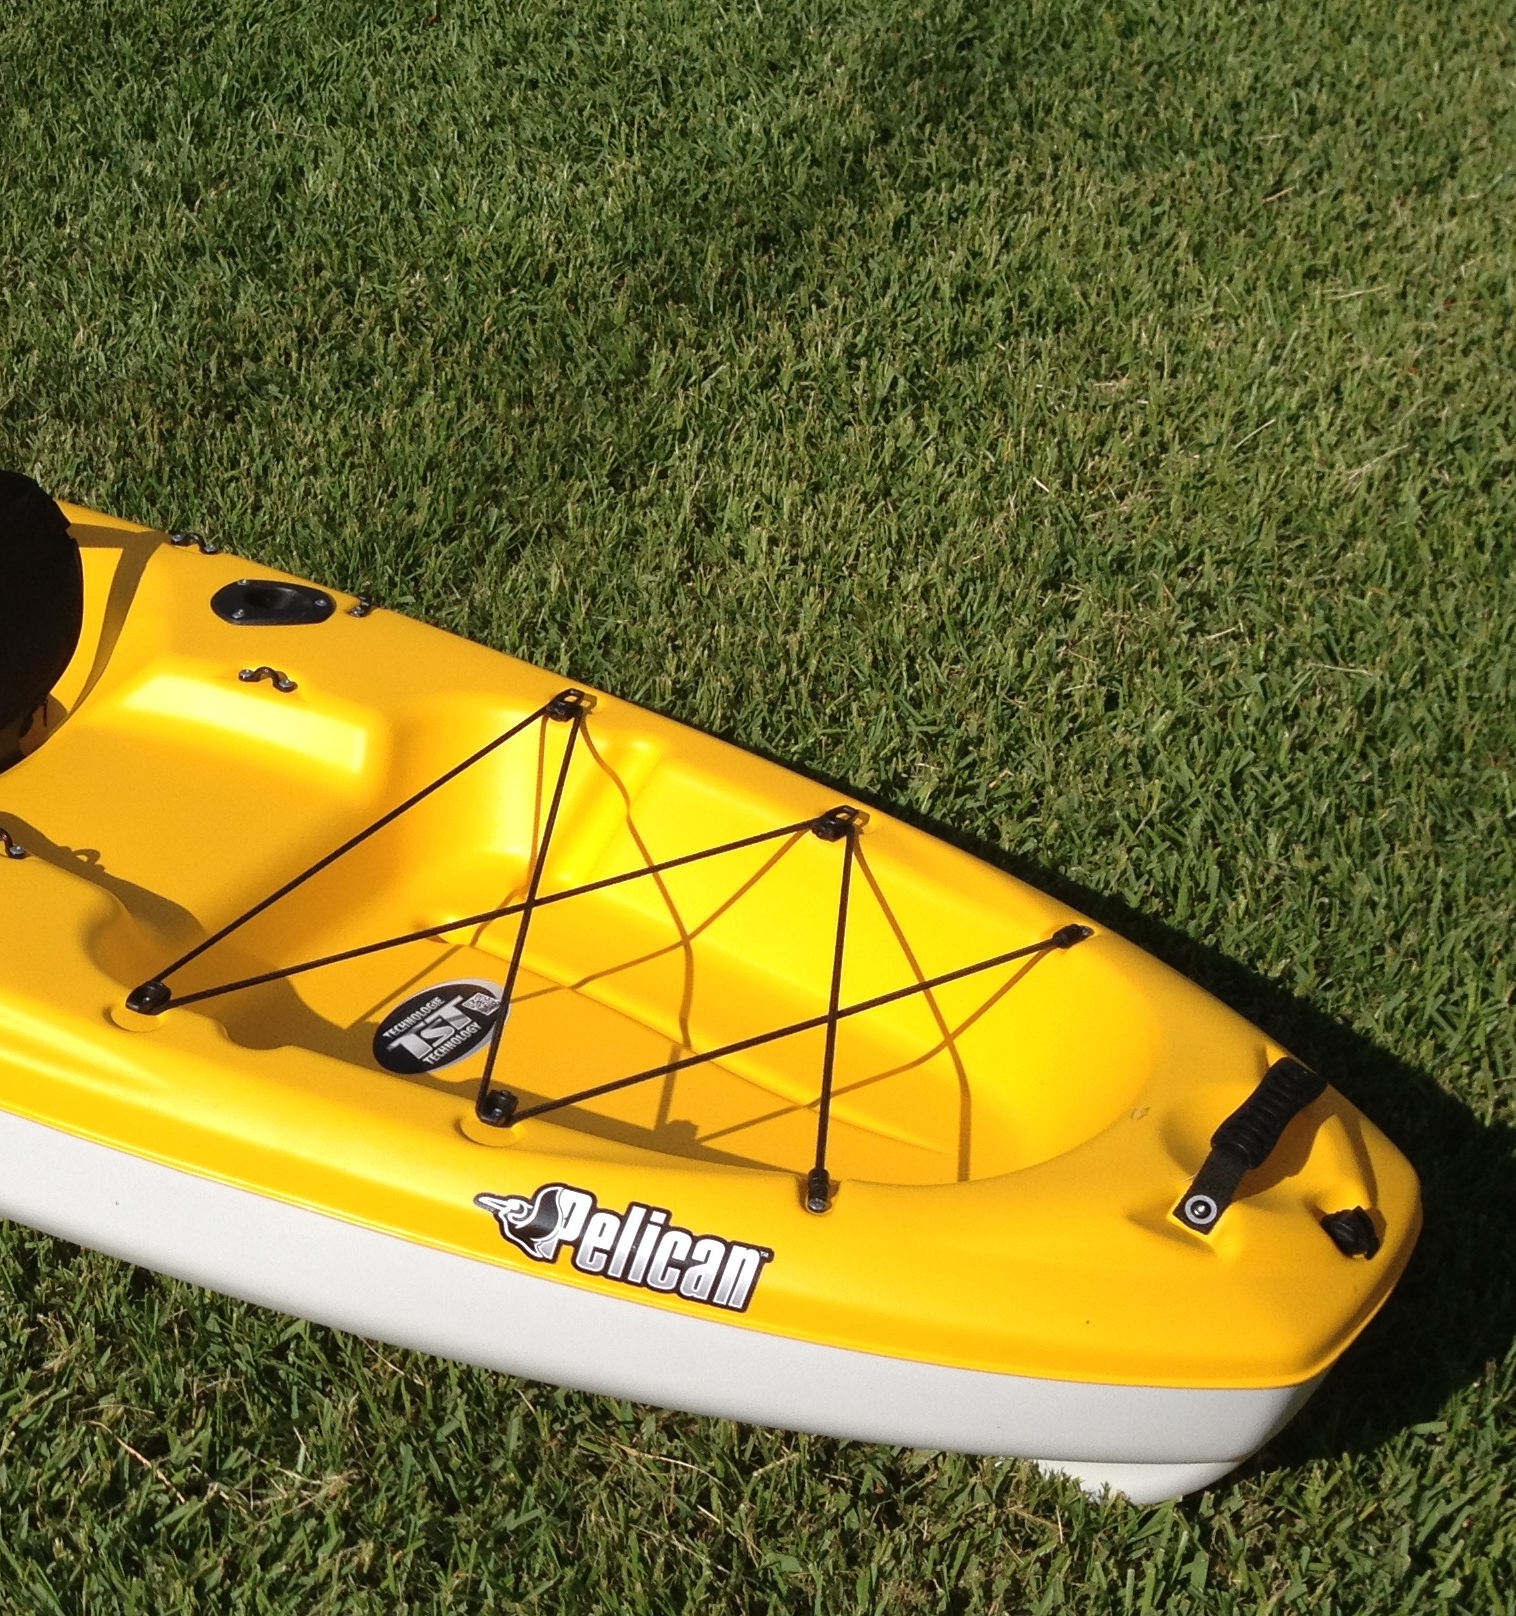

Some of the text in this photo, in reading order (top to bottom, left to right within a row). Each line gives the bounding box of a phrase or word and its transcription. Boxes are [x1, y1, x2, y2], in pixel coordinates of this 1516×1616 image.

[382, 996, 446, 1039] TECHNOLOGIE
[386, 994, 472, 1060] TST
[422, 1021, 482, 1066] TECHNOLOGY
[539, 1186, 762, 1310] Pelican
